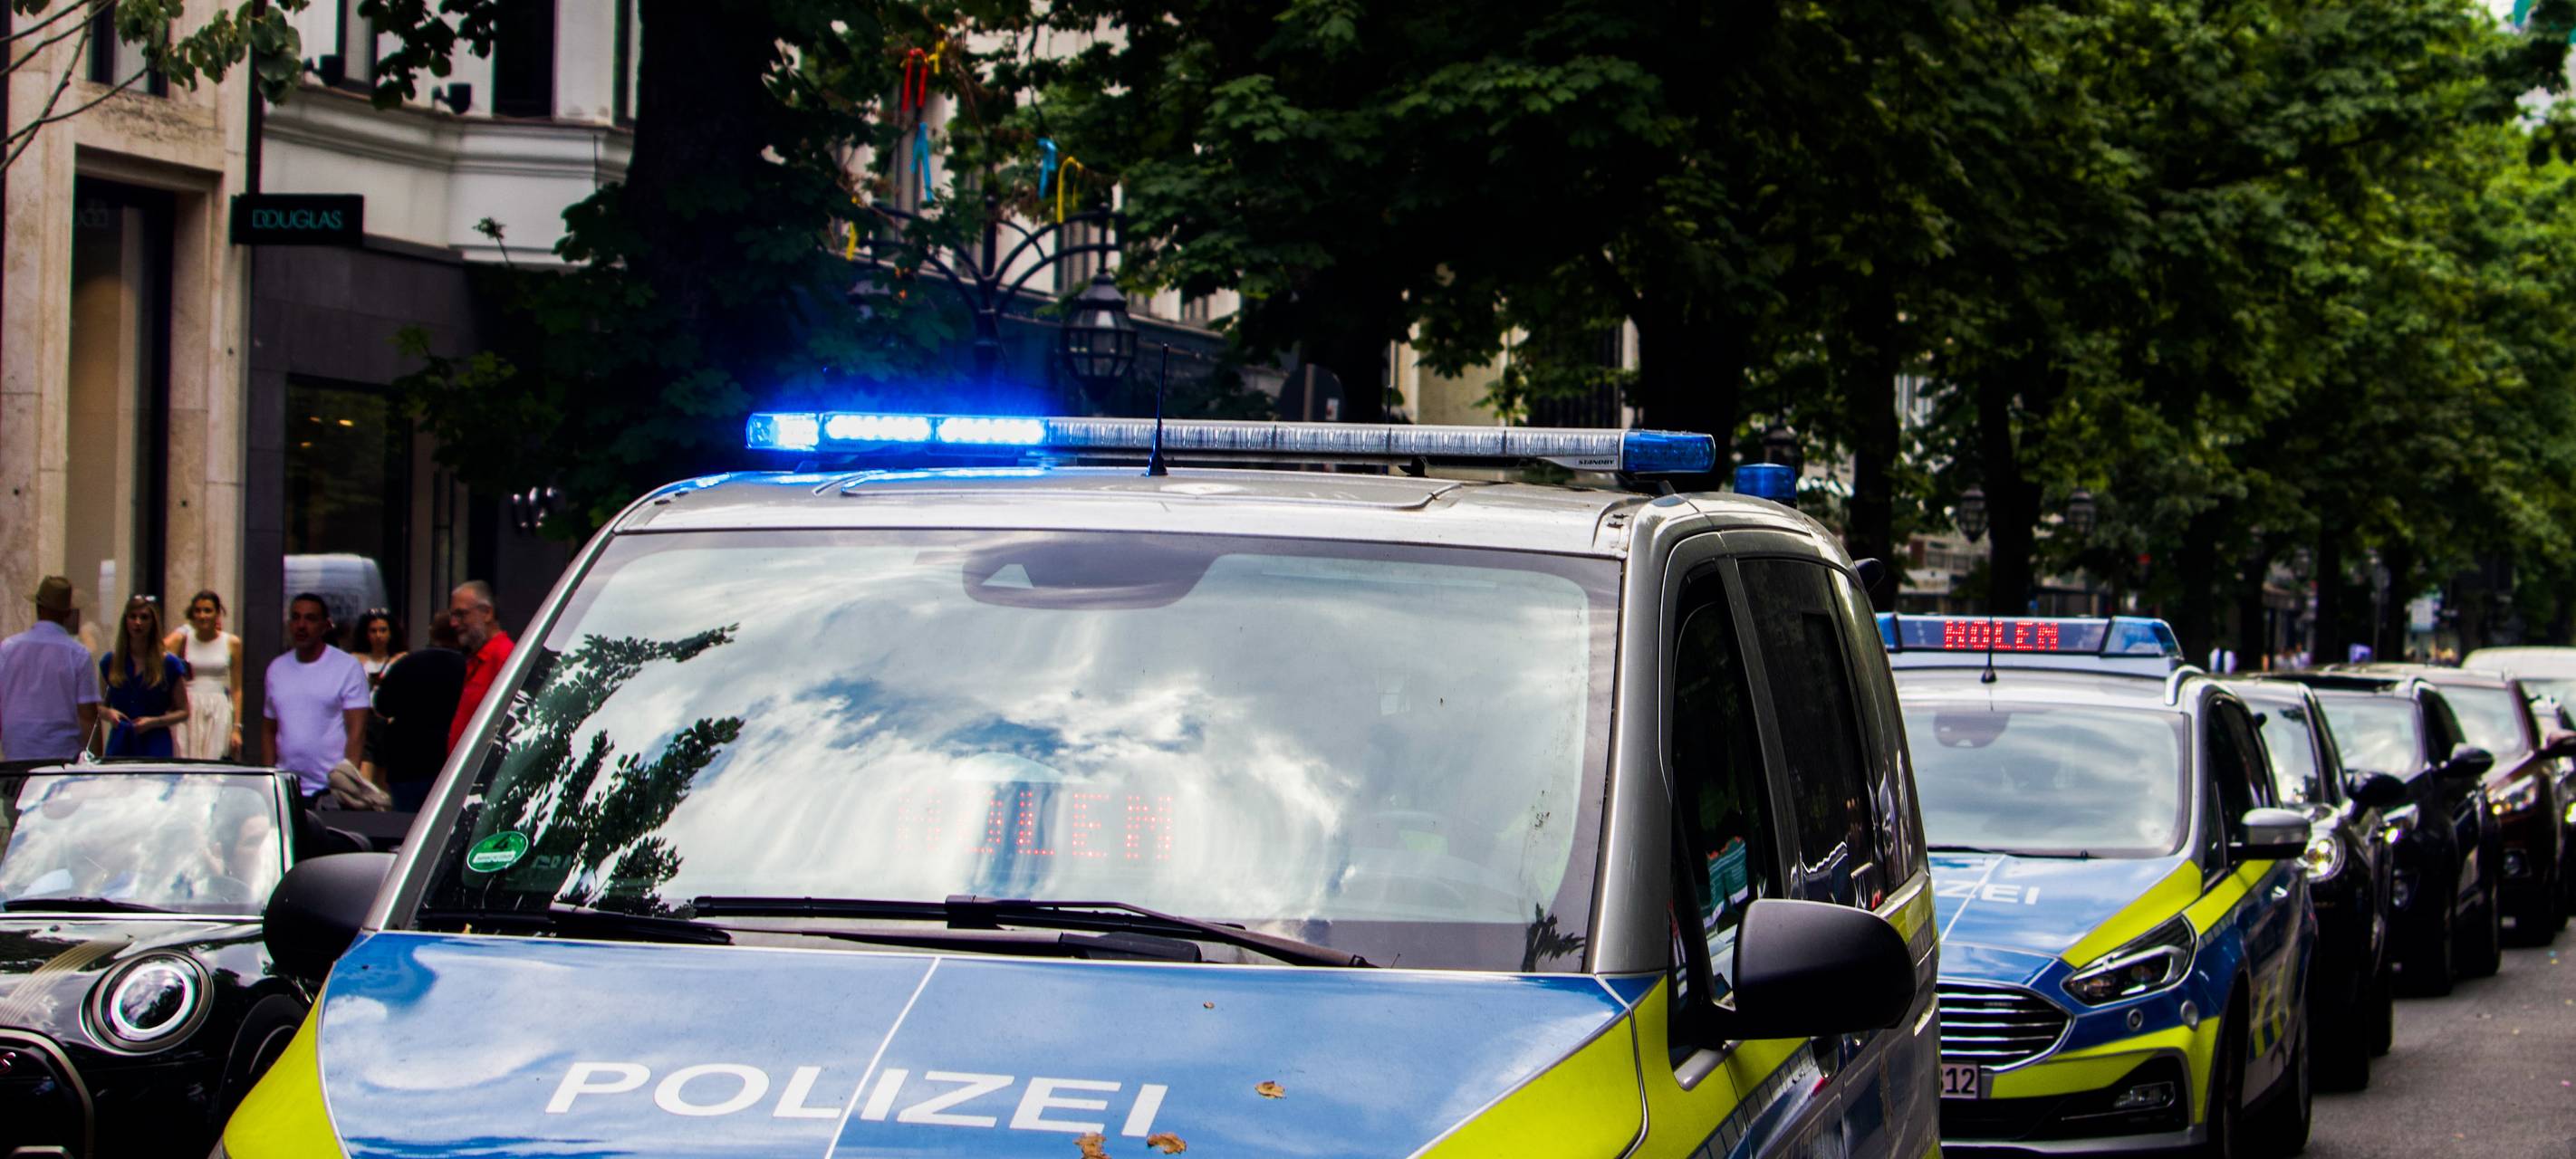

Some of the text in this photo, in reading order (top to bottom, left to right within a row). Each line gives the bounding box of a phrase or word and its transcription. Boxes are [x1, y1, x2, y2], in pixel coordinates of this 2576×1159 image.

[252, 209, 342, 228] DOUGLAS
[1940, 1068, 1975, 1094] 12
[544, 1062, 1168, 1137] POLIZEI
